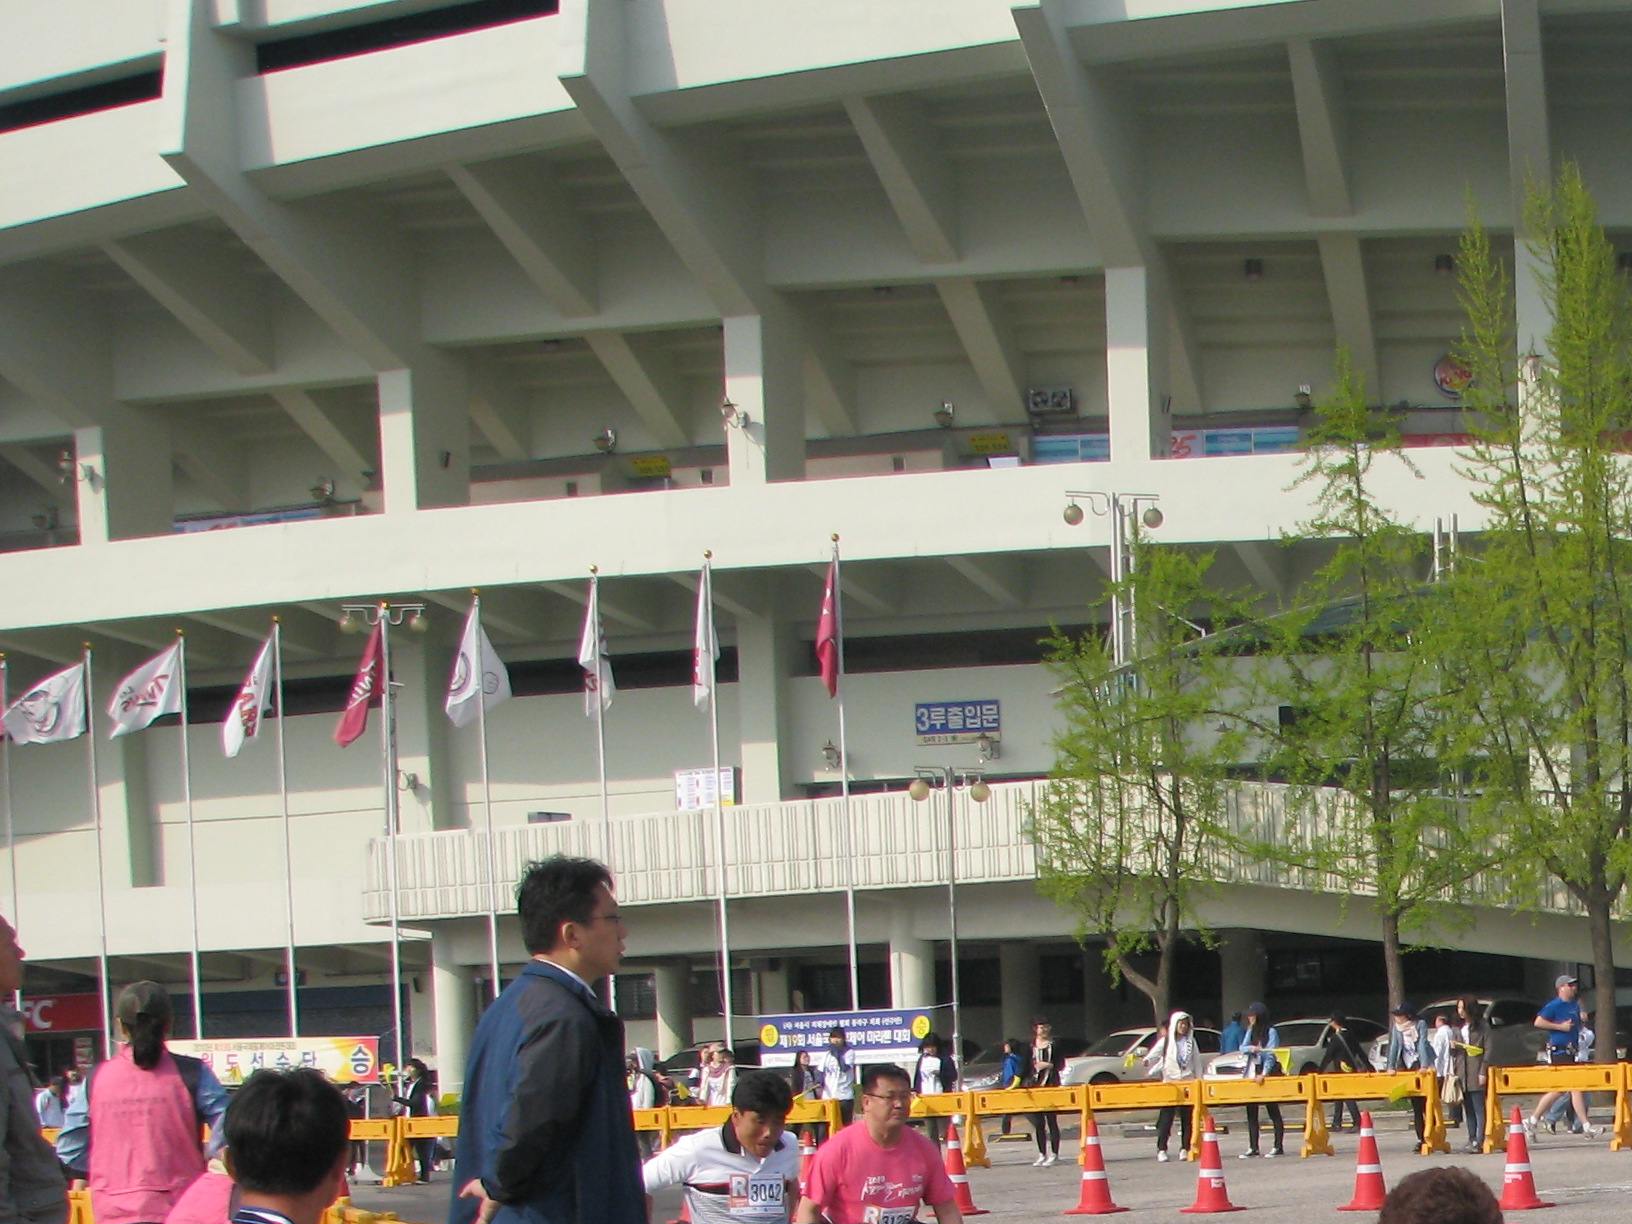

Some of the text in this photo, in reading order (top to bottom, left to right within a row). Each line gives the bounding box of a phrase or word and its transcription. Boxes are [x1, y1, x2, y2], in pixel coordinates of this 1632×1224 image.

[916, 704, 999, 731] 3루출입문
[10, 1000, 53, 1029] FC
[350, 1045, 370, 1075] 승
[731, 1176, 748, 1197] R
[750, 1183, 782, 1202] 3042
[864, 1205, 879, 1224] R
